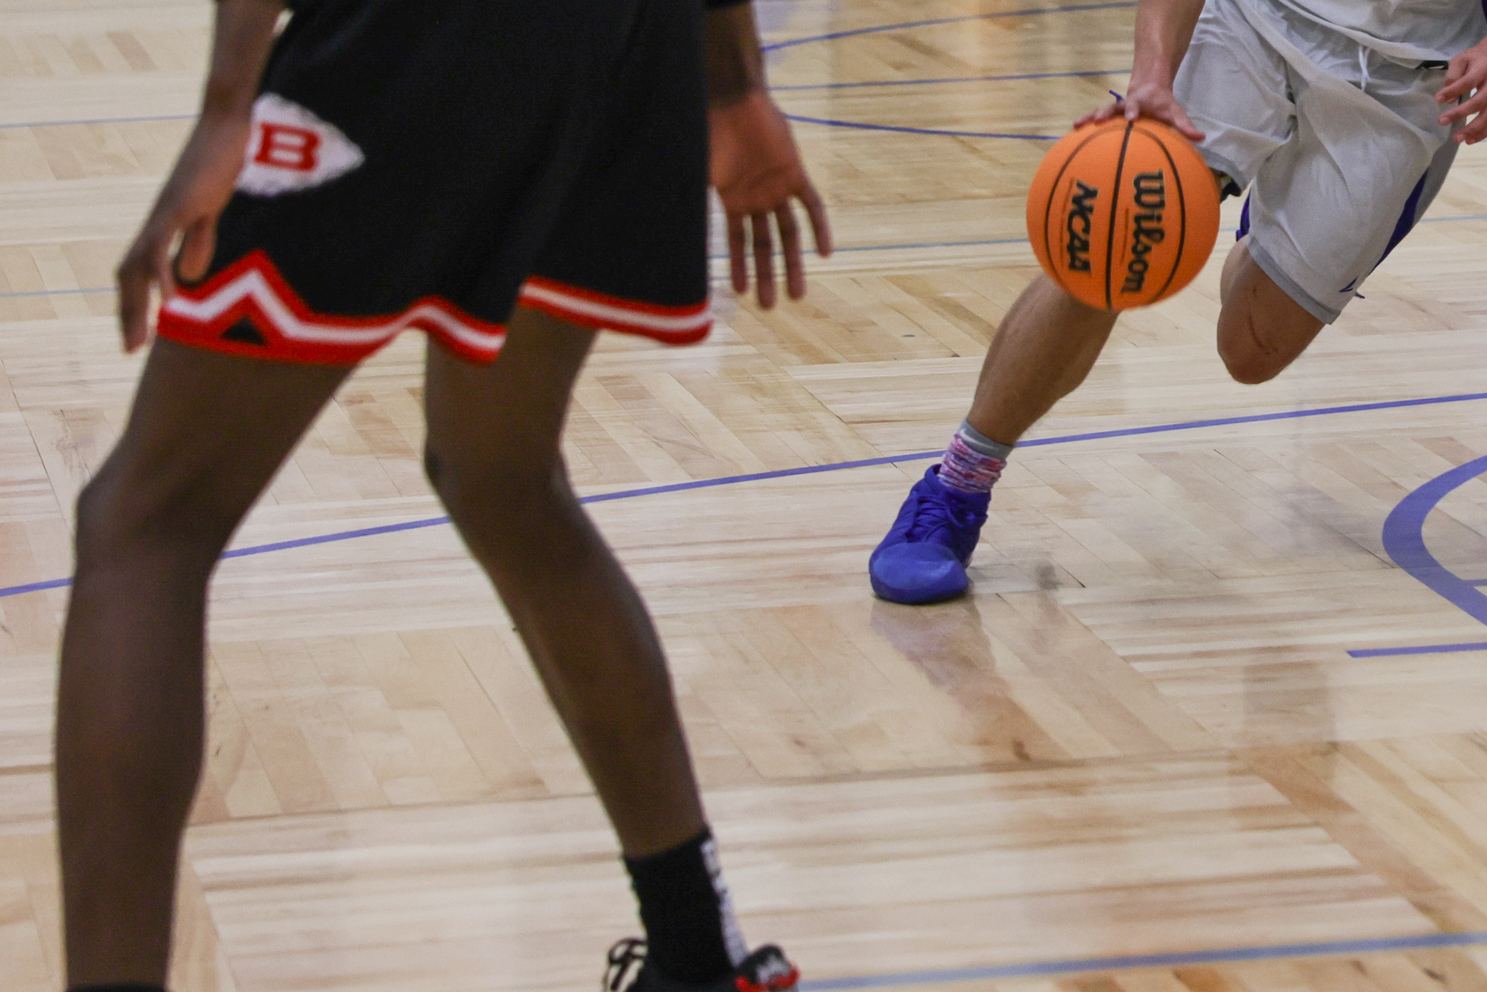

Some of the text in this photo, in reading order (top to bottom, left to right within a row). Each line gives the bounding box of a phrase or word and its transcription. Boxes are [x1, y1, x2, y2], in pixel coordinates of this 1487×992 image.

[254, 121, 321, 173] B
[1066, 179, 1099, 275] NCAA
[1120, 168, 1166, 295] Wilson
